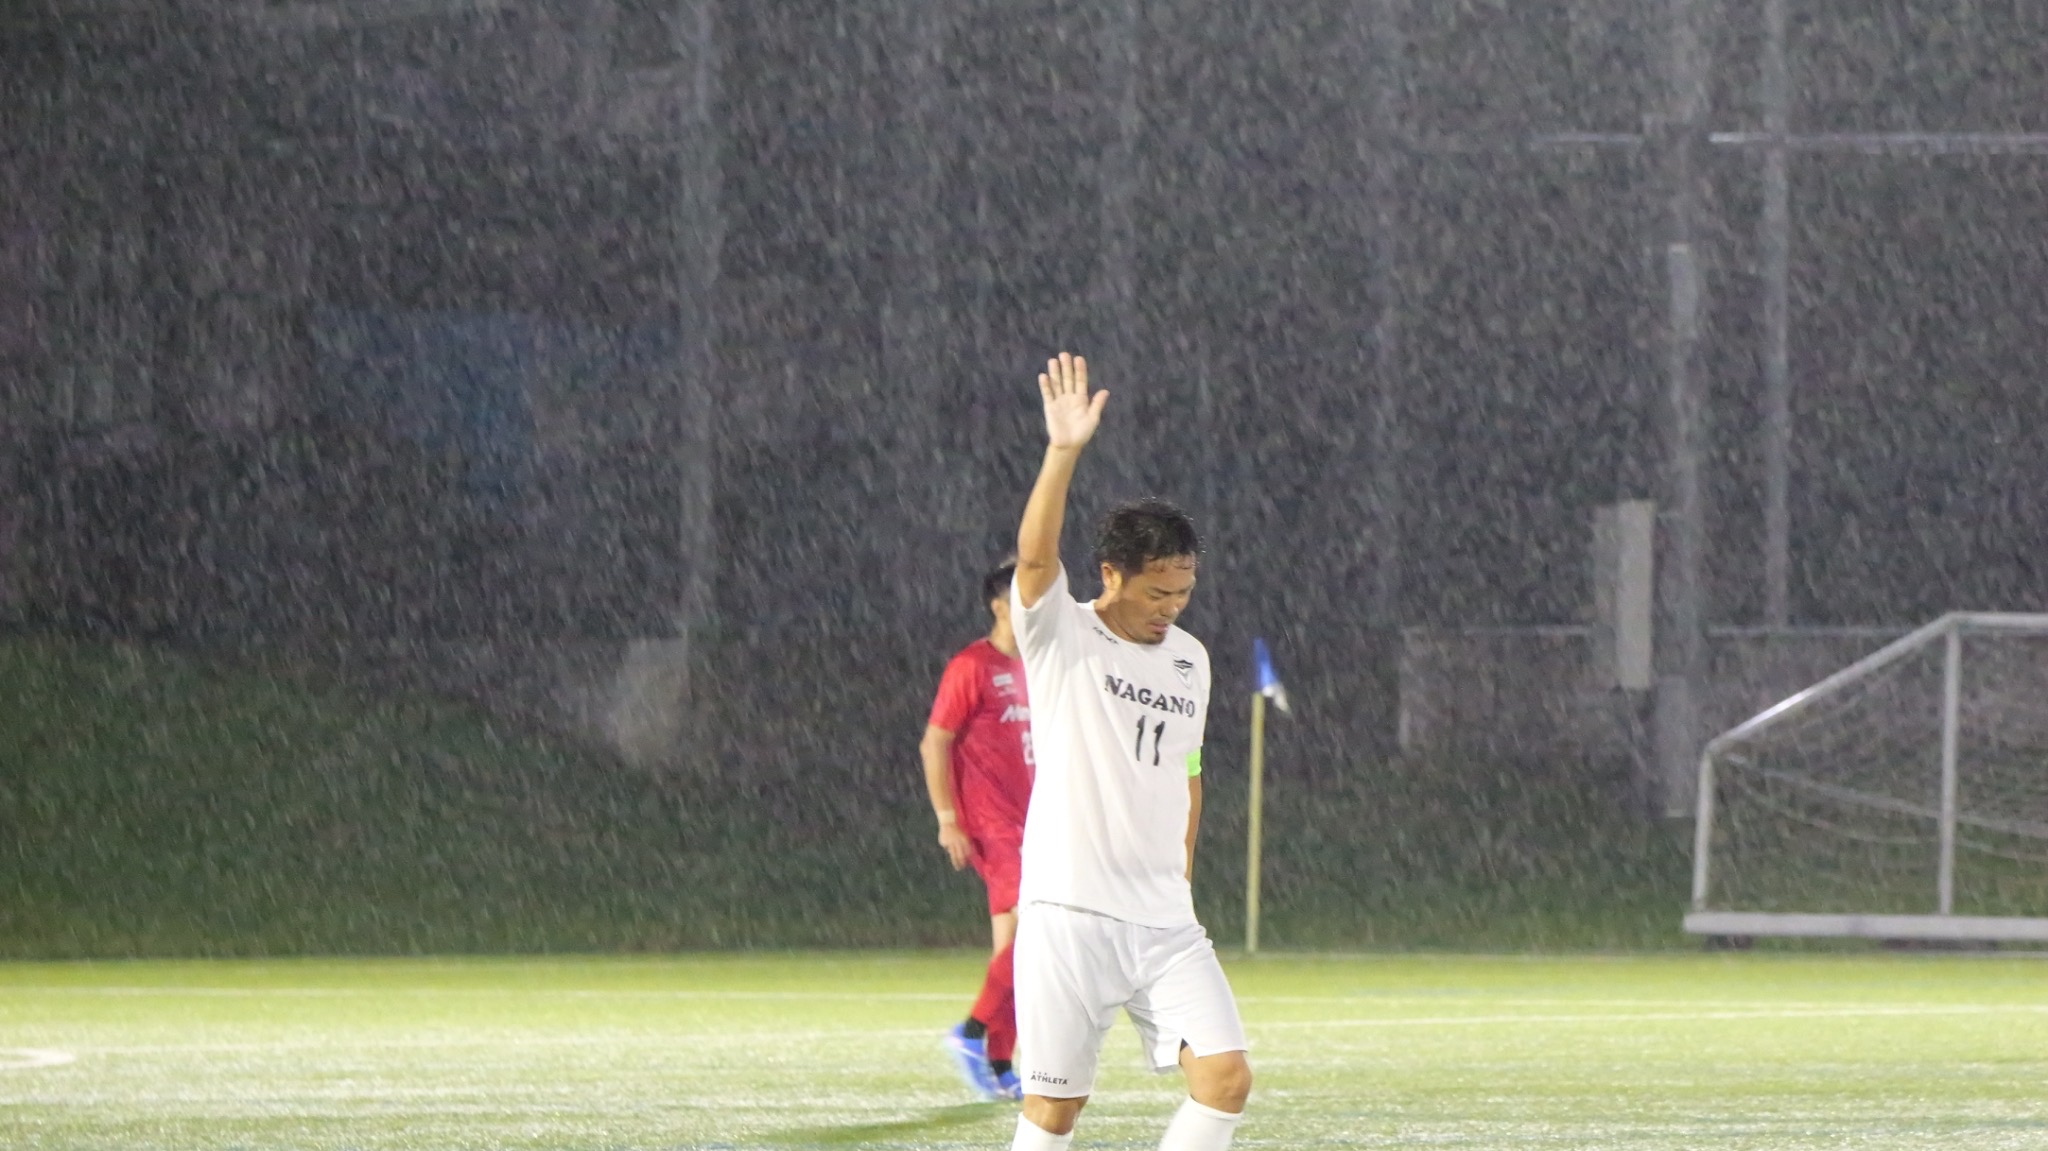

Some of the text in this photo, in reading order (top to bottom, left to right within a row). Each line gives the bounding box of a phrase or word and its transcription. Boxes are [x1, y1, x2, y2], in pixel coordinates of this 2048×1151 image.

[1104, 674, 1196, 718] NAGANO
[1135, 715, 1165, 766] 11
[1030, 1074, 1068, 1086] ATHLETA
